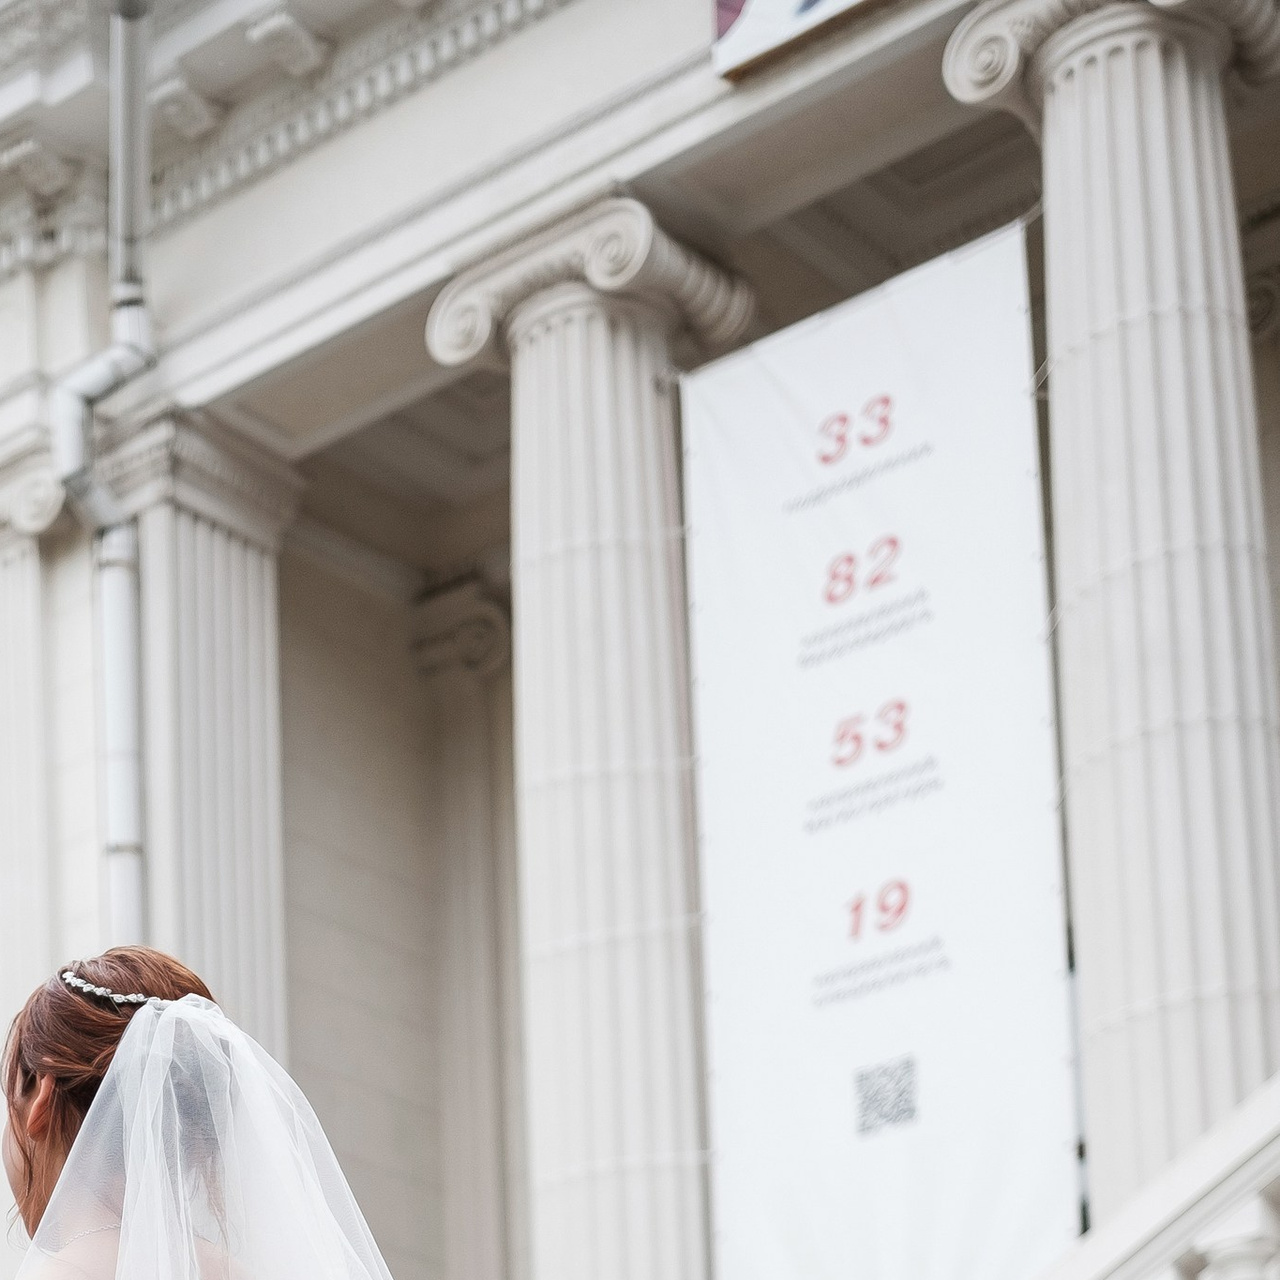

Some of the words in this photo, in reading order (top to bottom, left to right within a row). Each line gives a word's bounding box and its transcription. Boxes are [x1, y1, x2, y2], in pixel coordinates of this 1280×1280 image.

[817, 394, 893, 465] 33
[823, 534, 900, 605] 82
[832, 697, 909, 767] 53
[845, 878, 910, 942] 19
